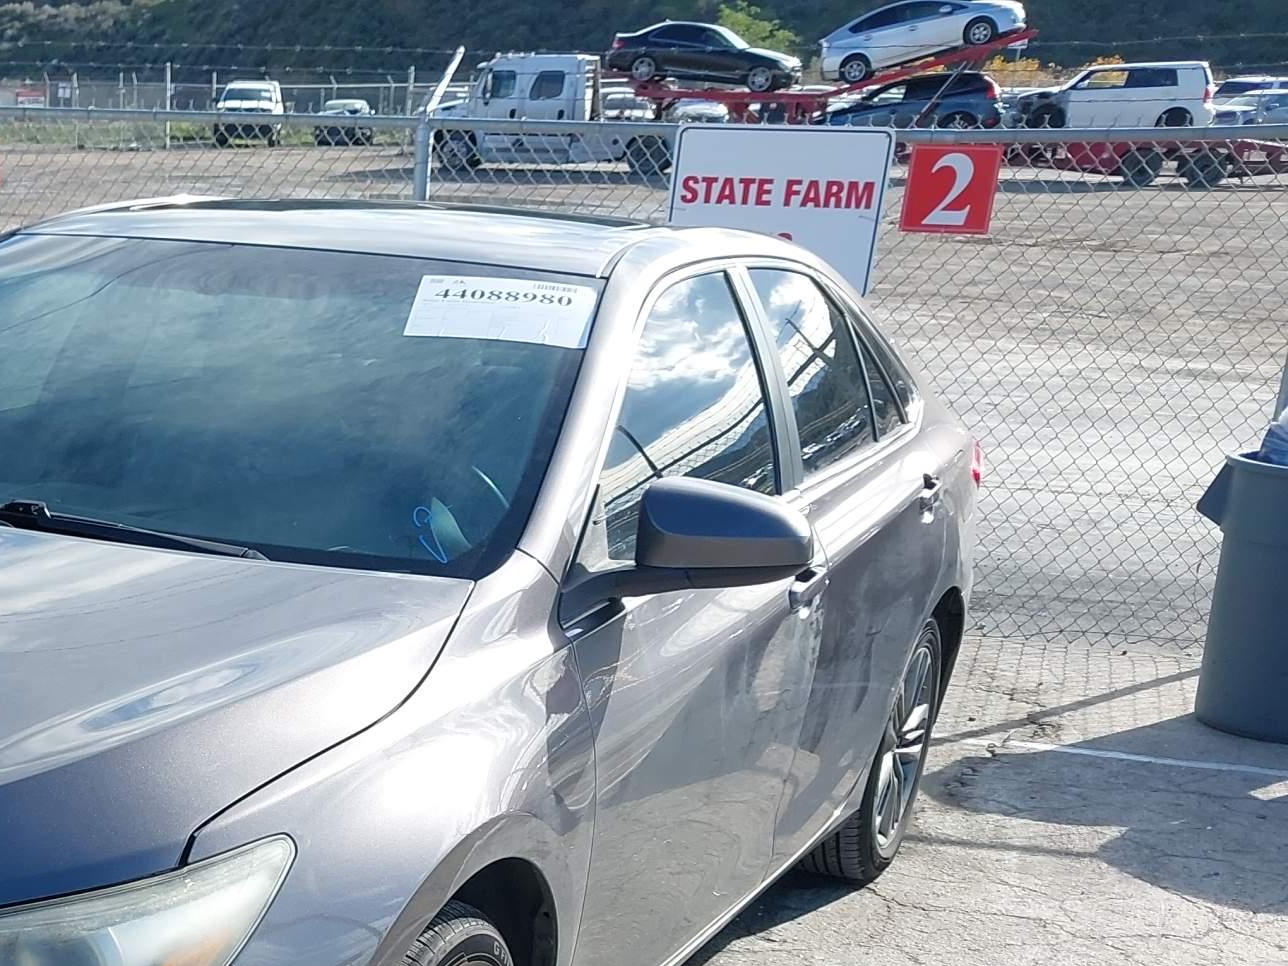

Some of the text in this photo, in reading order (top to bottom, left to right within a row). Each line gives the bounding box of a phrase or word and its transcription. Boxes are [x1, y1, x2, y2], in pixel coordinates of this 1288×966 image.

[680, 176, 875, 210] STATE FARM
[921, 152, 975, 226] 2
[434, 287, 573, 307] 44088980
